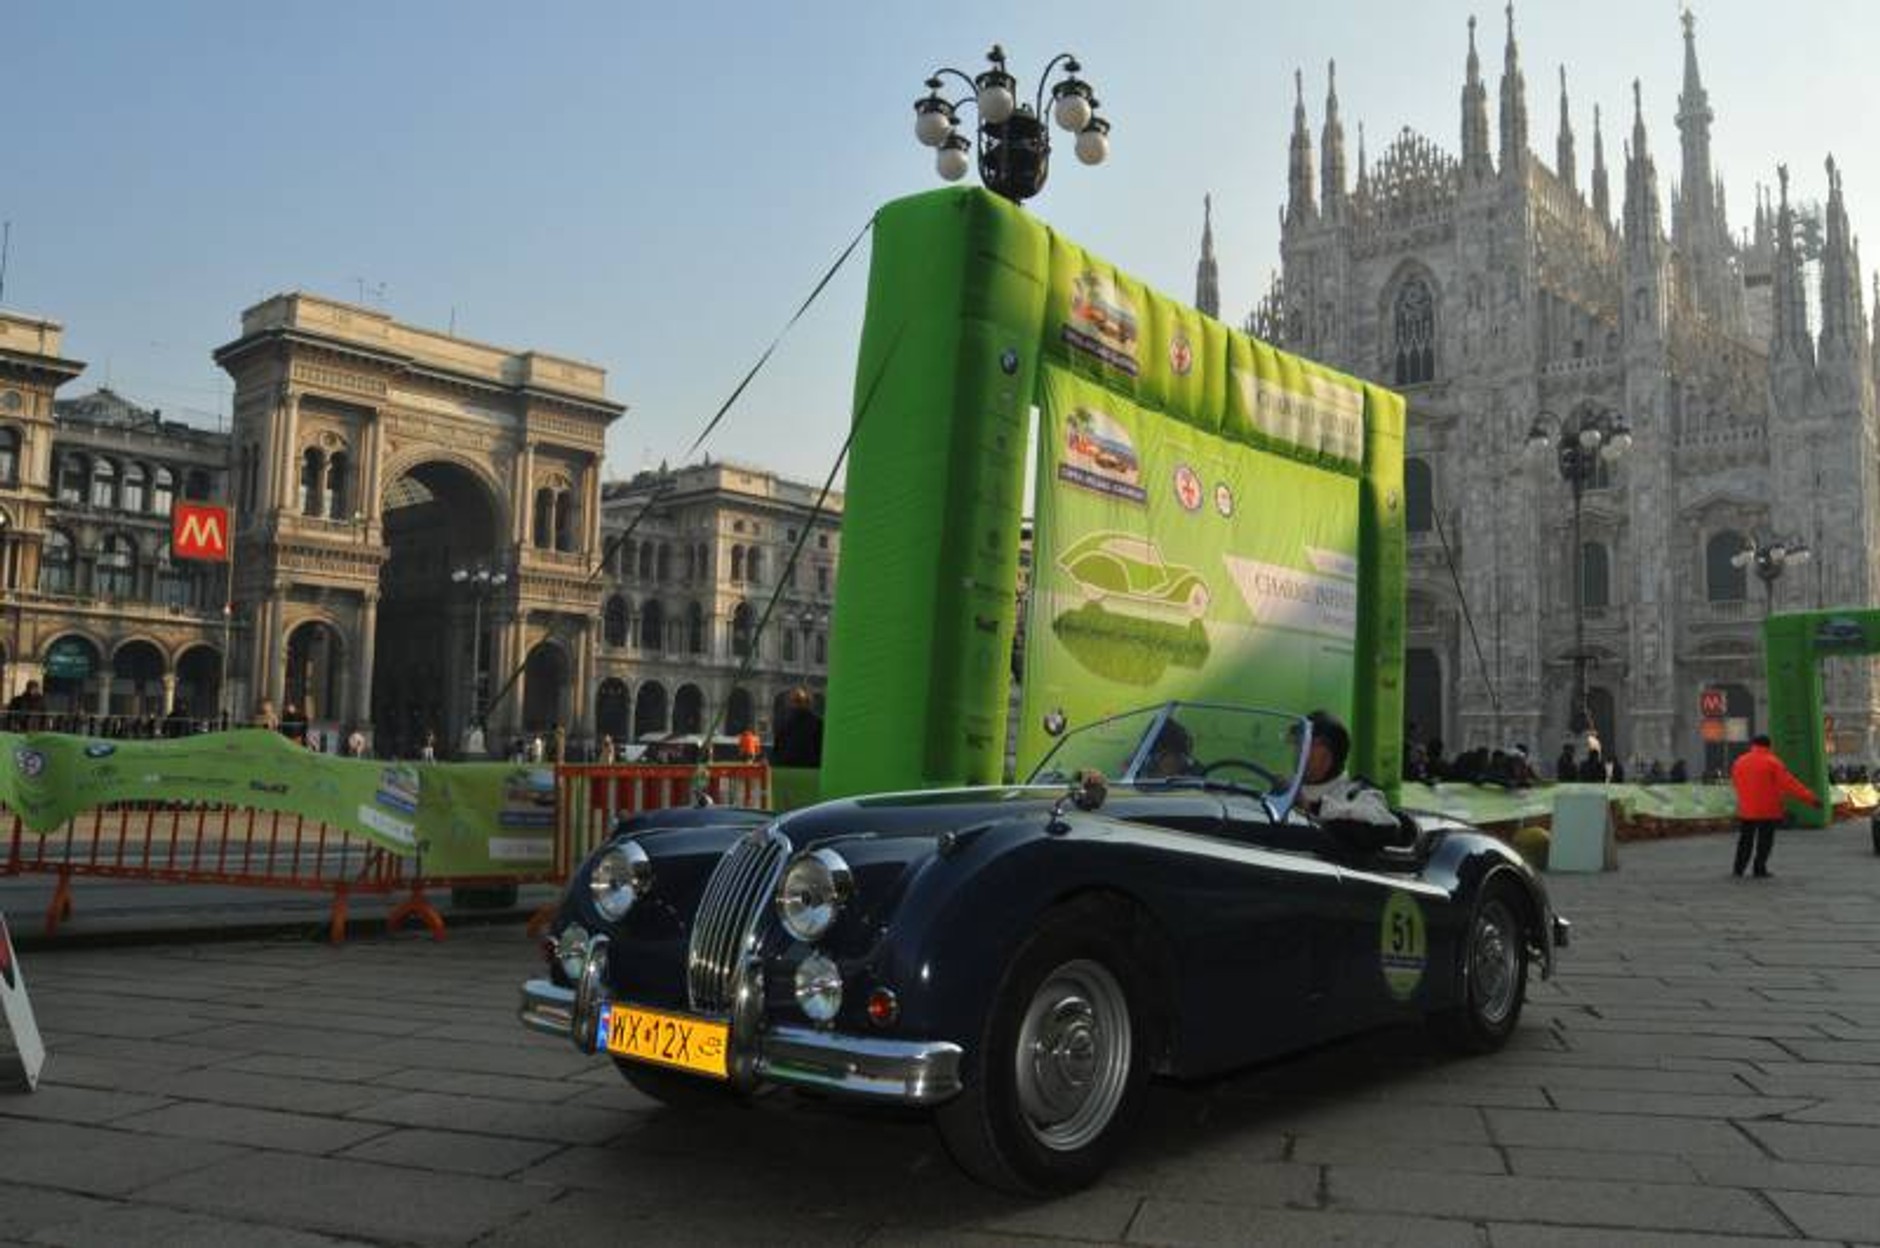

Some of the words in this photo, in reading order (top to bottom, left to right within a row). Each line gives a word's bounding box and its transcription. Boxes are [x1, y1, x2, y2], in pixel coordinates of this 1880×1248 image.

[178, 514, 224, 550] M
[1391, 911, 1415, 953] 51
[611, 1012, 643, 1051] WX
[653, 1019, 694, 1062] 12X
